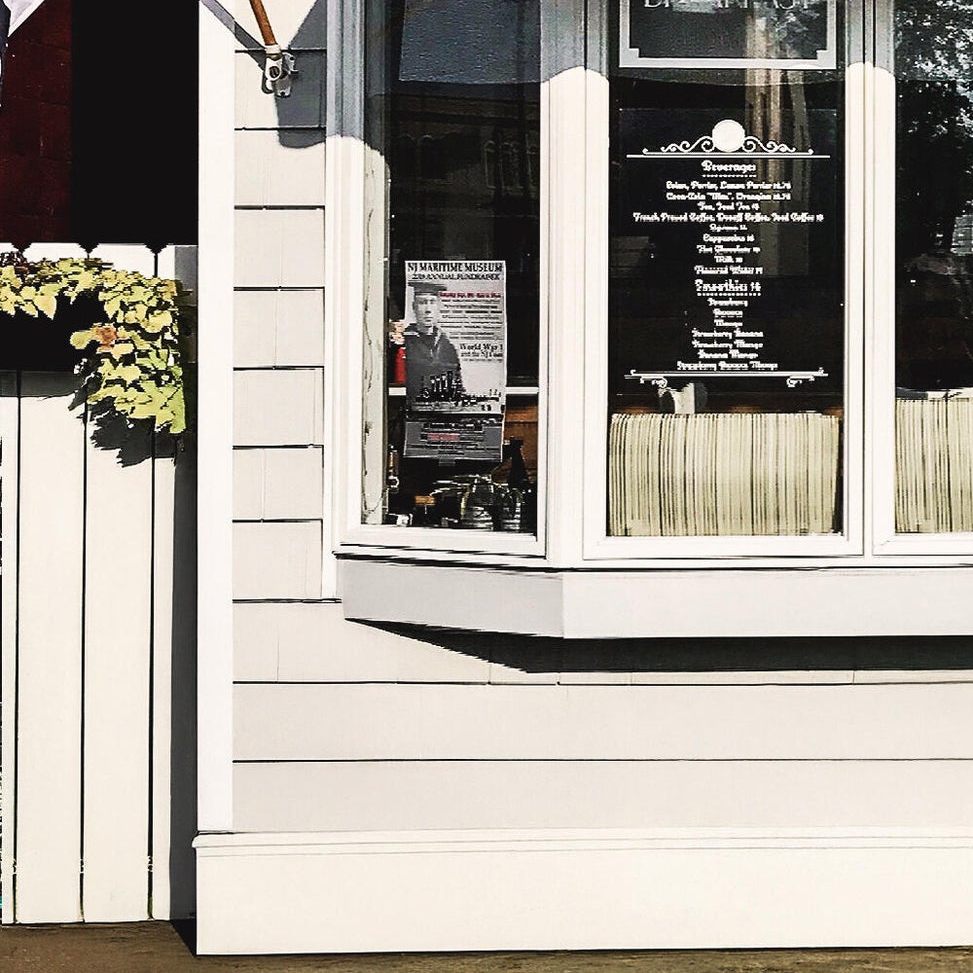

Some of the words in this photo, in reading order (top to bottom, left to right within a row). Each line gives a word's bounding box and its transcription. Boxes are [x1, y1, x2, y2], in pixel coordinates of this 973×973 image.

[700, 159, 757, 174] Beverages
[419, 262, 463, 272] MARITIME
[465, 262, 503, 272] MUSEUM
[460, 343, 481, 352] World
[483, 343, 499, 352] War
